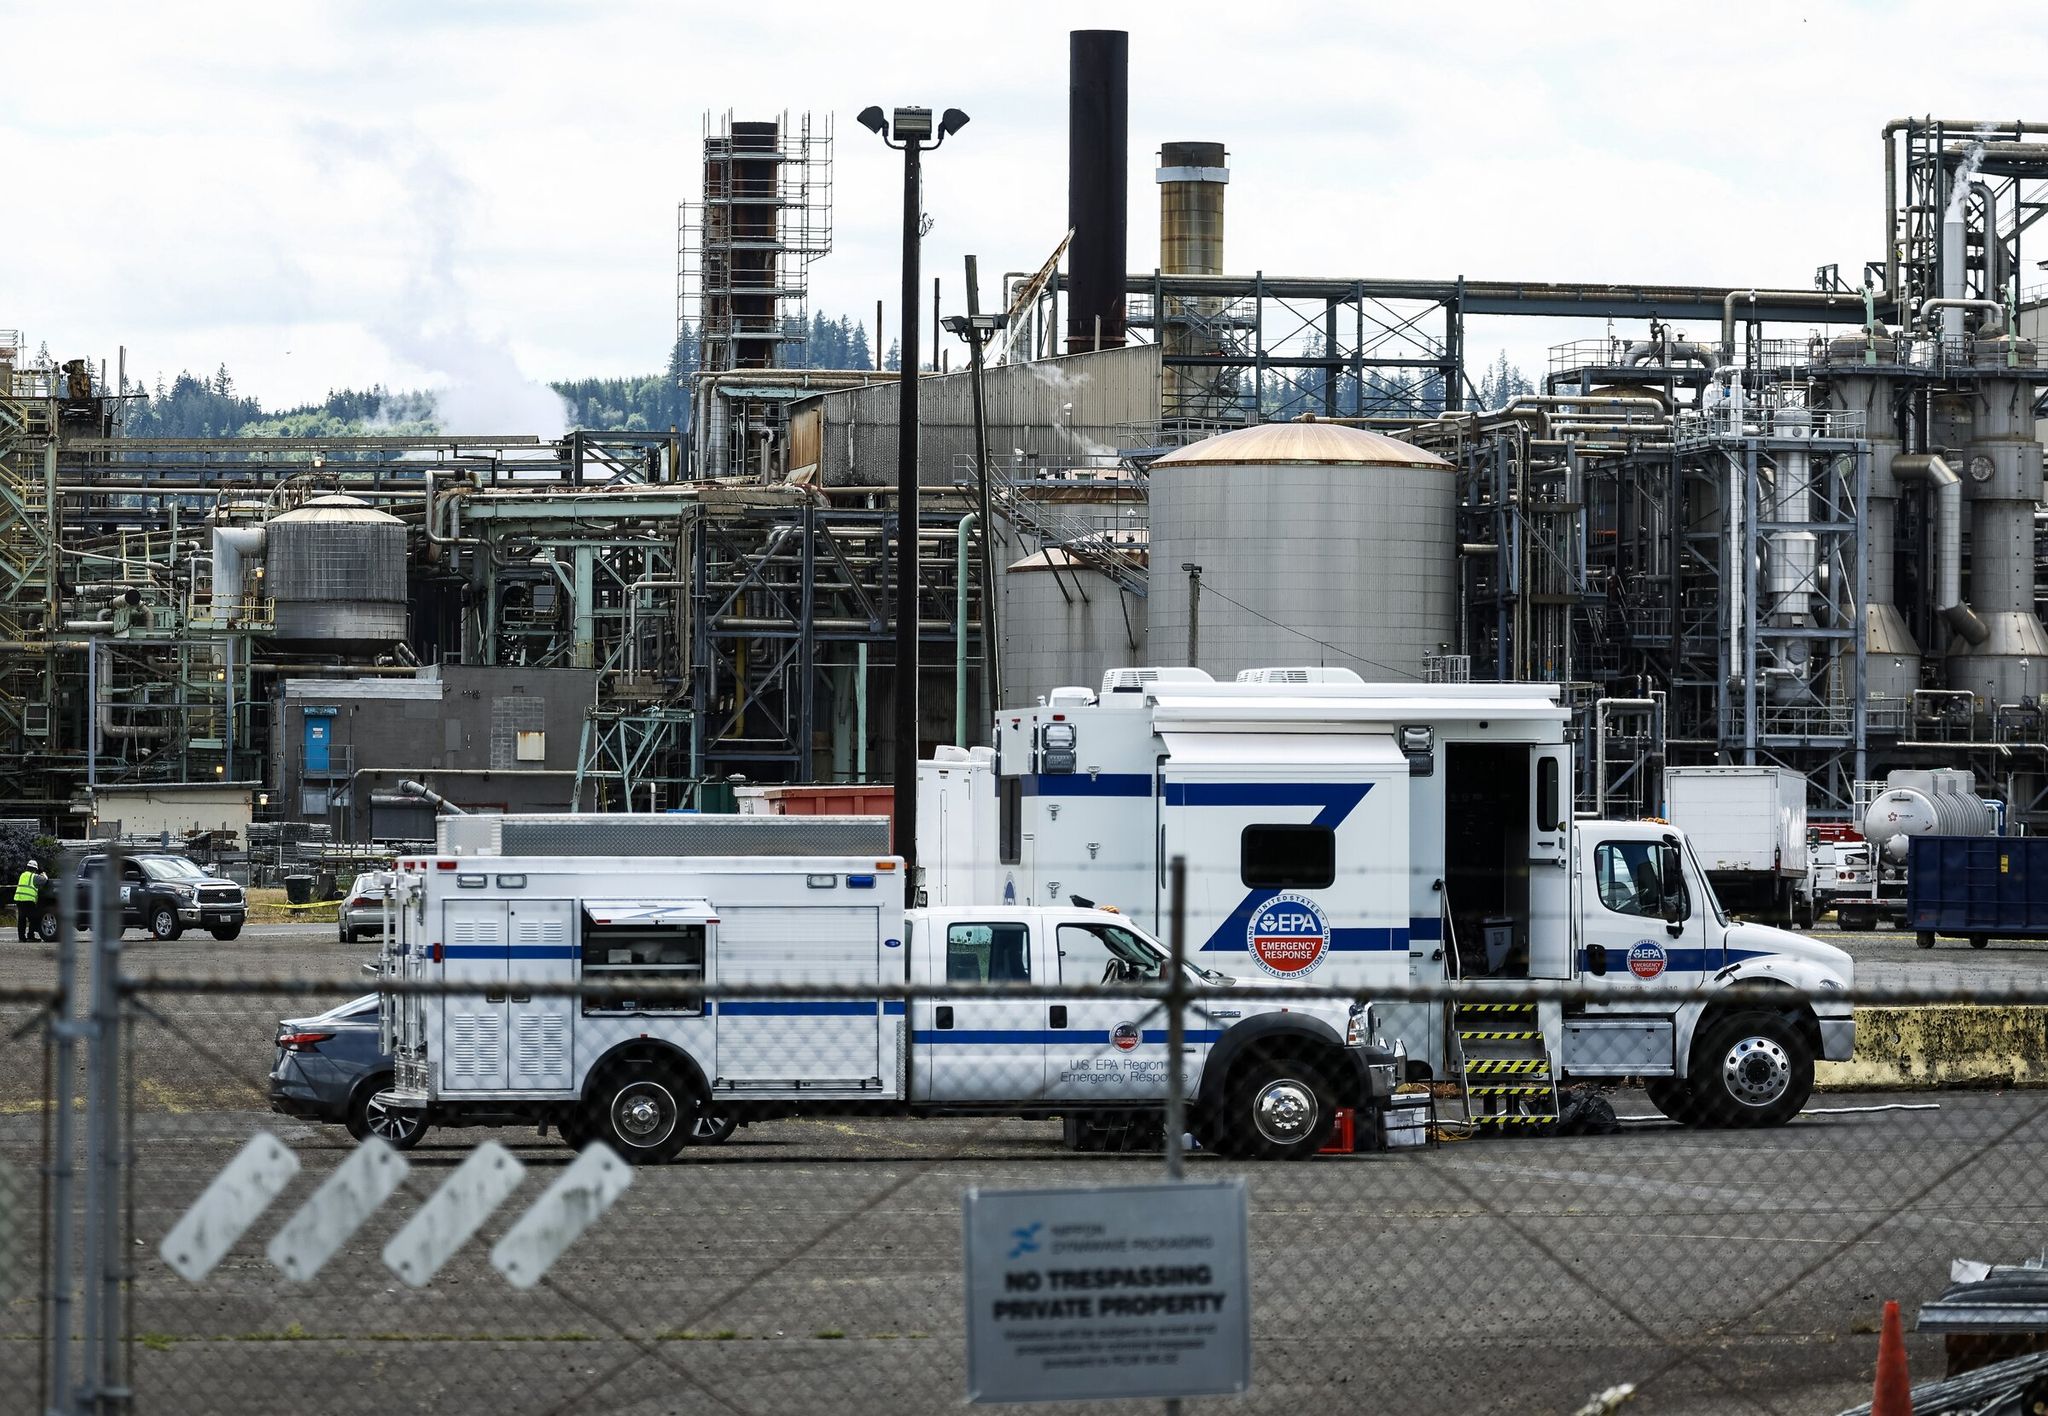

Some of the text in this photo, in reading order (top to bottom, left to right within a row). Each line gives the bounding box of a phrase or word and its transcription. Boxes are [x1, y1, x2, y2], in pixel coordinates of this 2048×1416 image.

[1279, 914, 1317, 931] EPA
[1261, 942, 1316, 950] EMERGENCY
[1265, 951, 1312, 959] RESPONSE
[1642, 949, 1661, 958] EPA
[1070, 1060, 1164, 1073] U.S. EPA Region
[1061, 1072, 1189, 1085] Emergency Respoe
[1005, 1265, 1213, 1292] NO TRESPASSING
[993, 1292, 1226, 1321] PRIVATE PROPERTY
